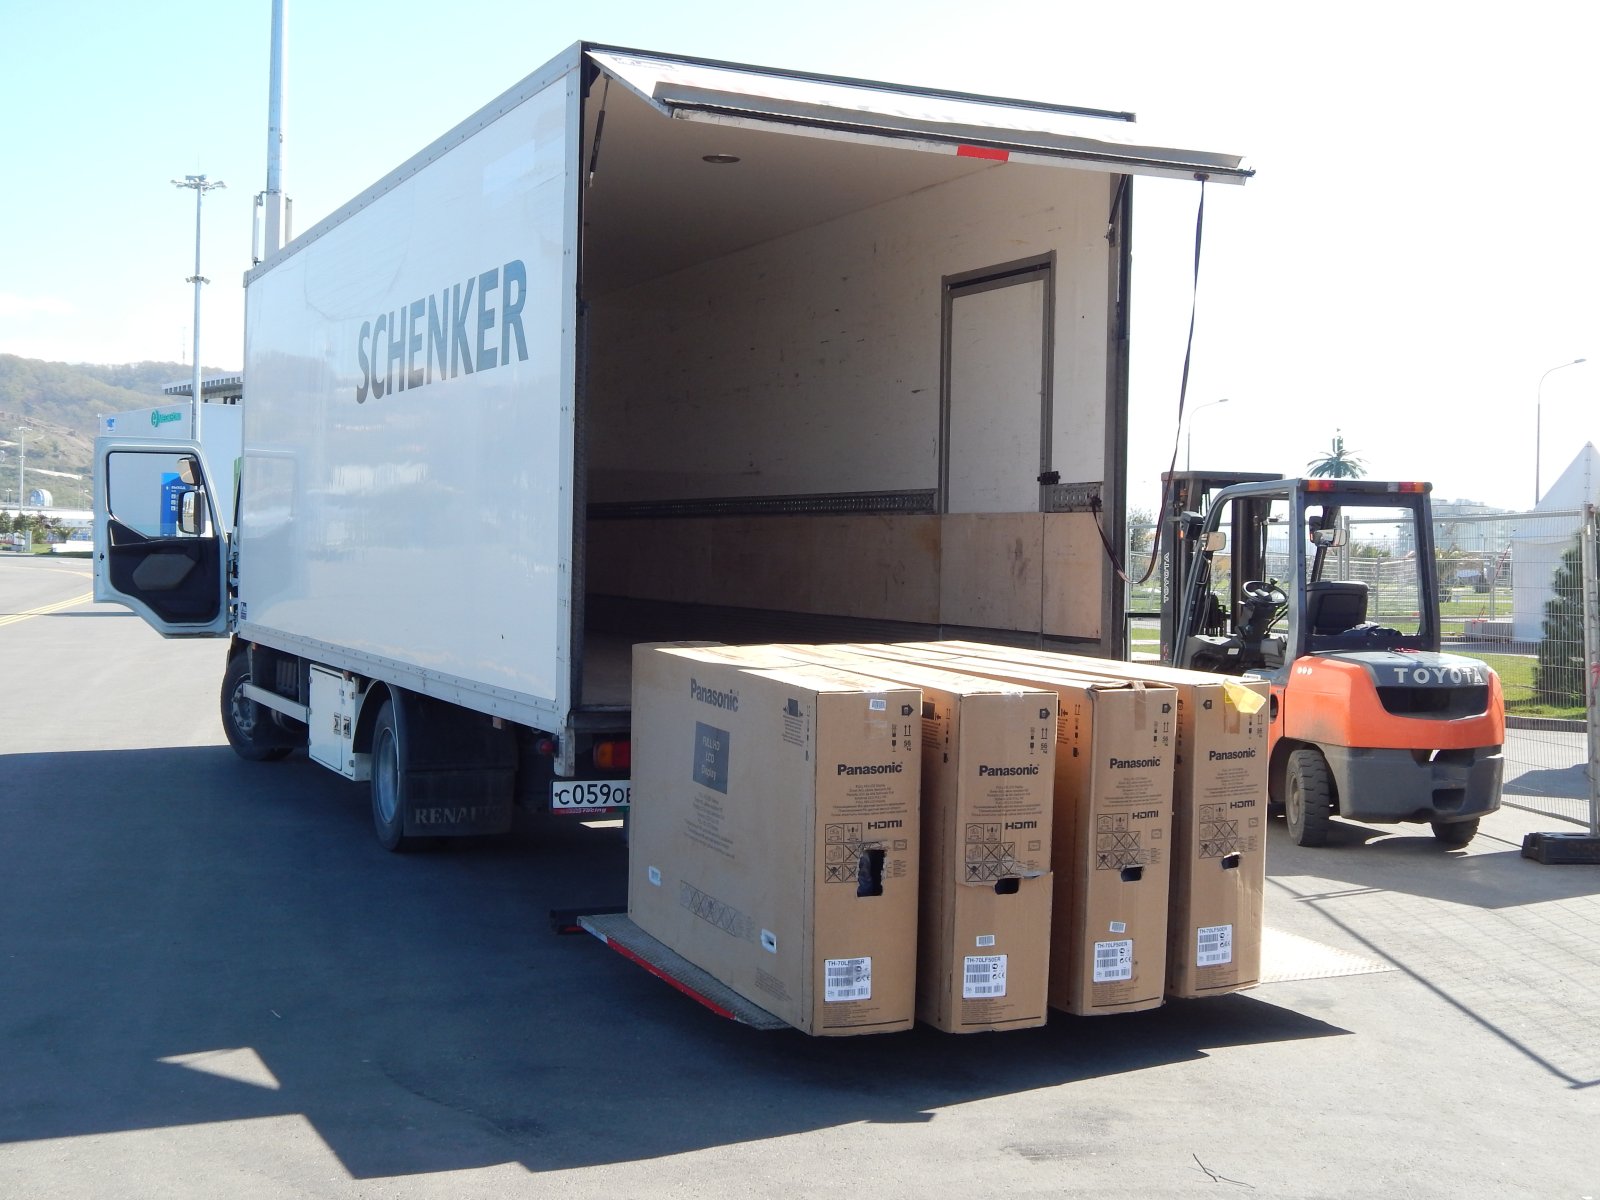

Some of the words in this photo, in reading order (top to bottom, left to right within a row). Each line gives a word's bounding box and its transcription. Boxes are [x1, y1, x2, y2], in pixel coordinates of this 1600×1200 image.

[356, 259, 529, 404] SCHENKER
[1393, 666, 1485, 685] TOYOTA
[690, 678, 739, 712] Panasonic
[1209, 747, 1256, 761] Panasonic
[837, 761, 903, 776] Panasonic
[1109, 756, 1161, 769] Panasonic
[979, 763, 1039, 776] Panasonic
[1229, 800, 1256, 809] HDMI
[1132, 810, 1159, 820] HDMI
[867, 819, 903, 830] HDMI
[1005, 820, 1037, 830] HDMI
